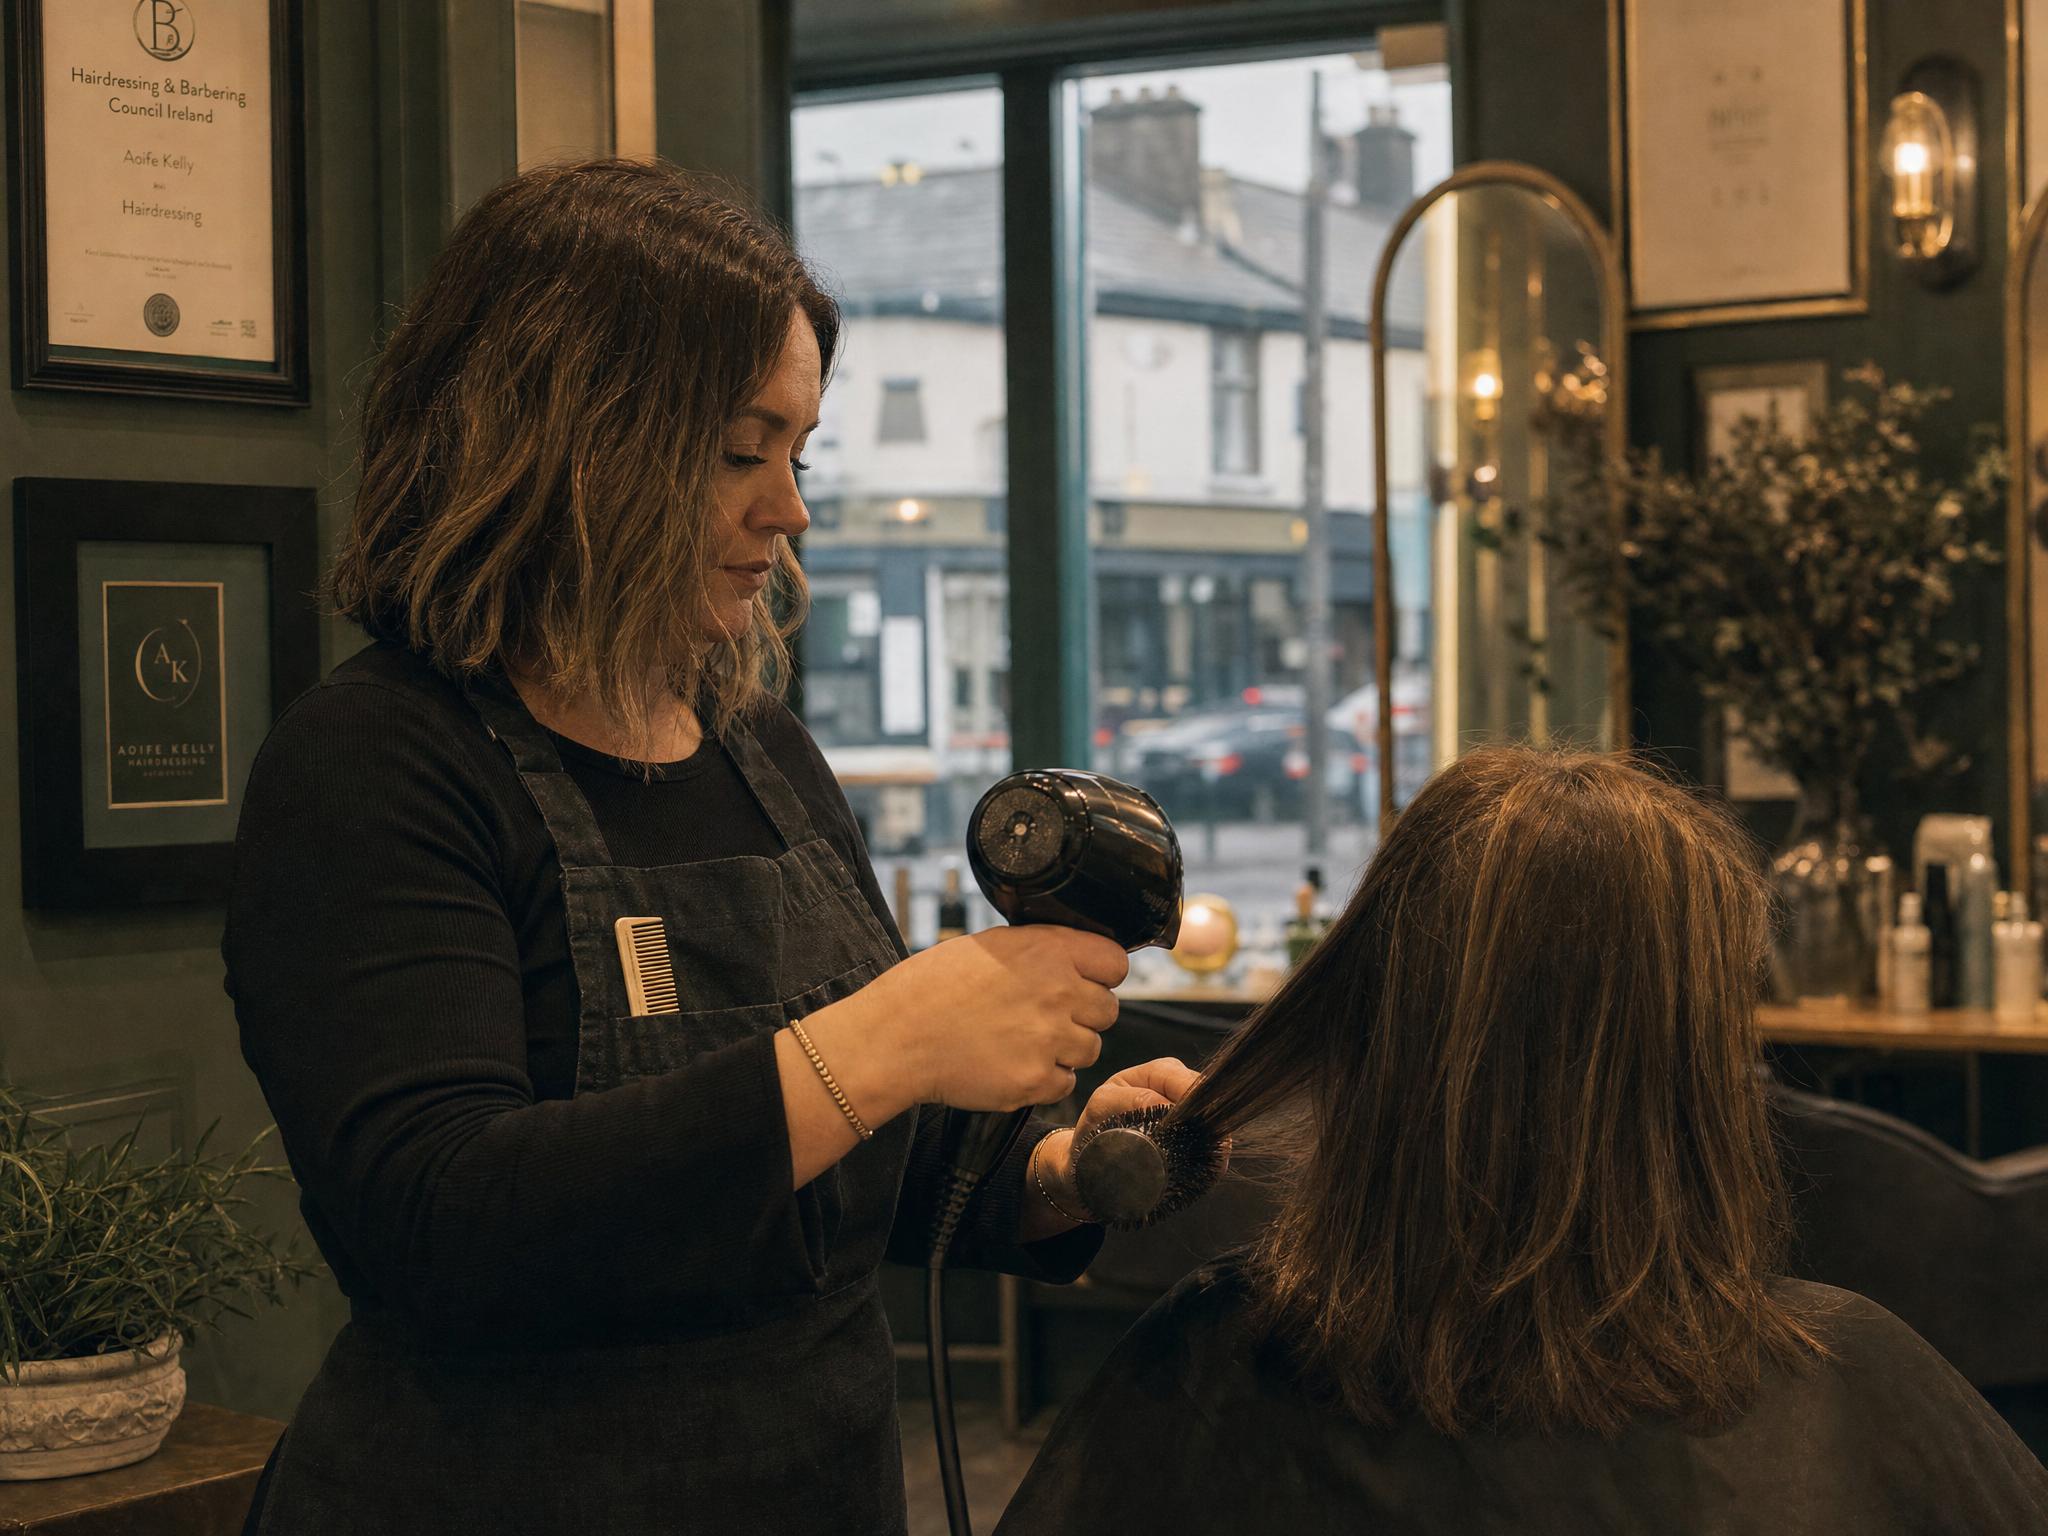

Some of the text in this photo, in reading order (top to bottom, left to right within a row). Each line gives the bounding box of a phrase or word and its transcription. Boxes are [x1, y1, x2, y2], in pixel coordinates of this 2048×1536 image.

[71, 67, 247, 108] Hairdressing & Barbering
[108, 97, 213, 124] Council Ireland
[123, 149, 194, 176] Aoife Kelly
[122, 200, 203, 228] Hairdressing
[117, 743, 216, 756] AOIFE KELLY
